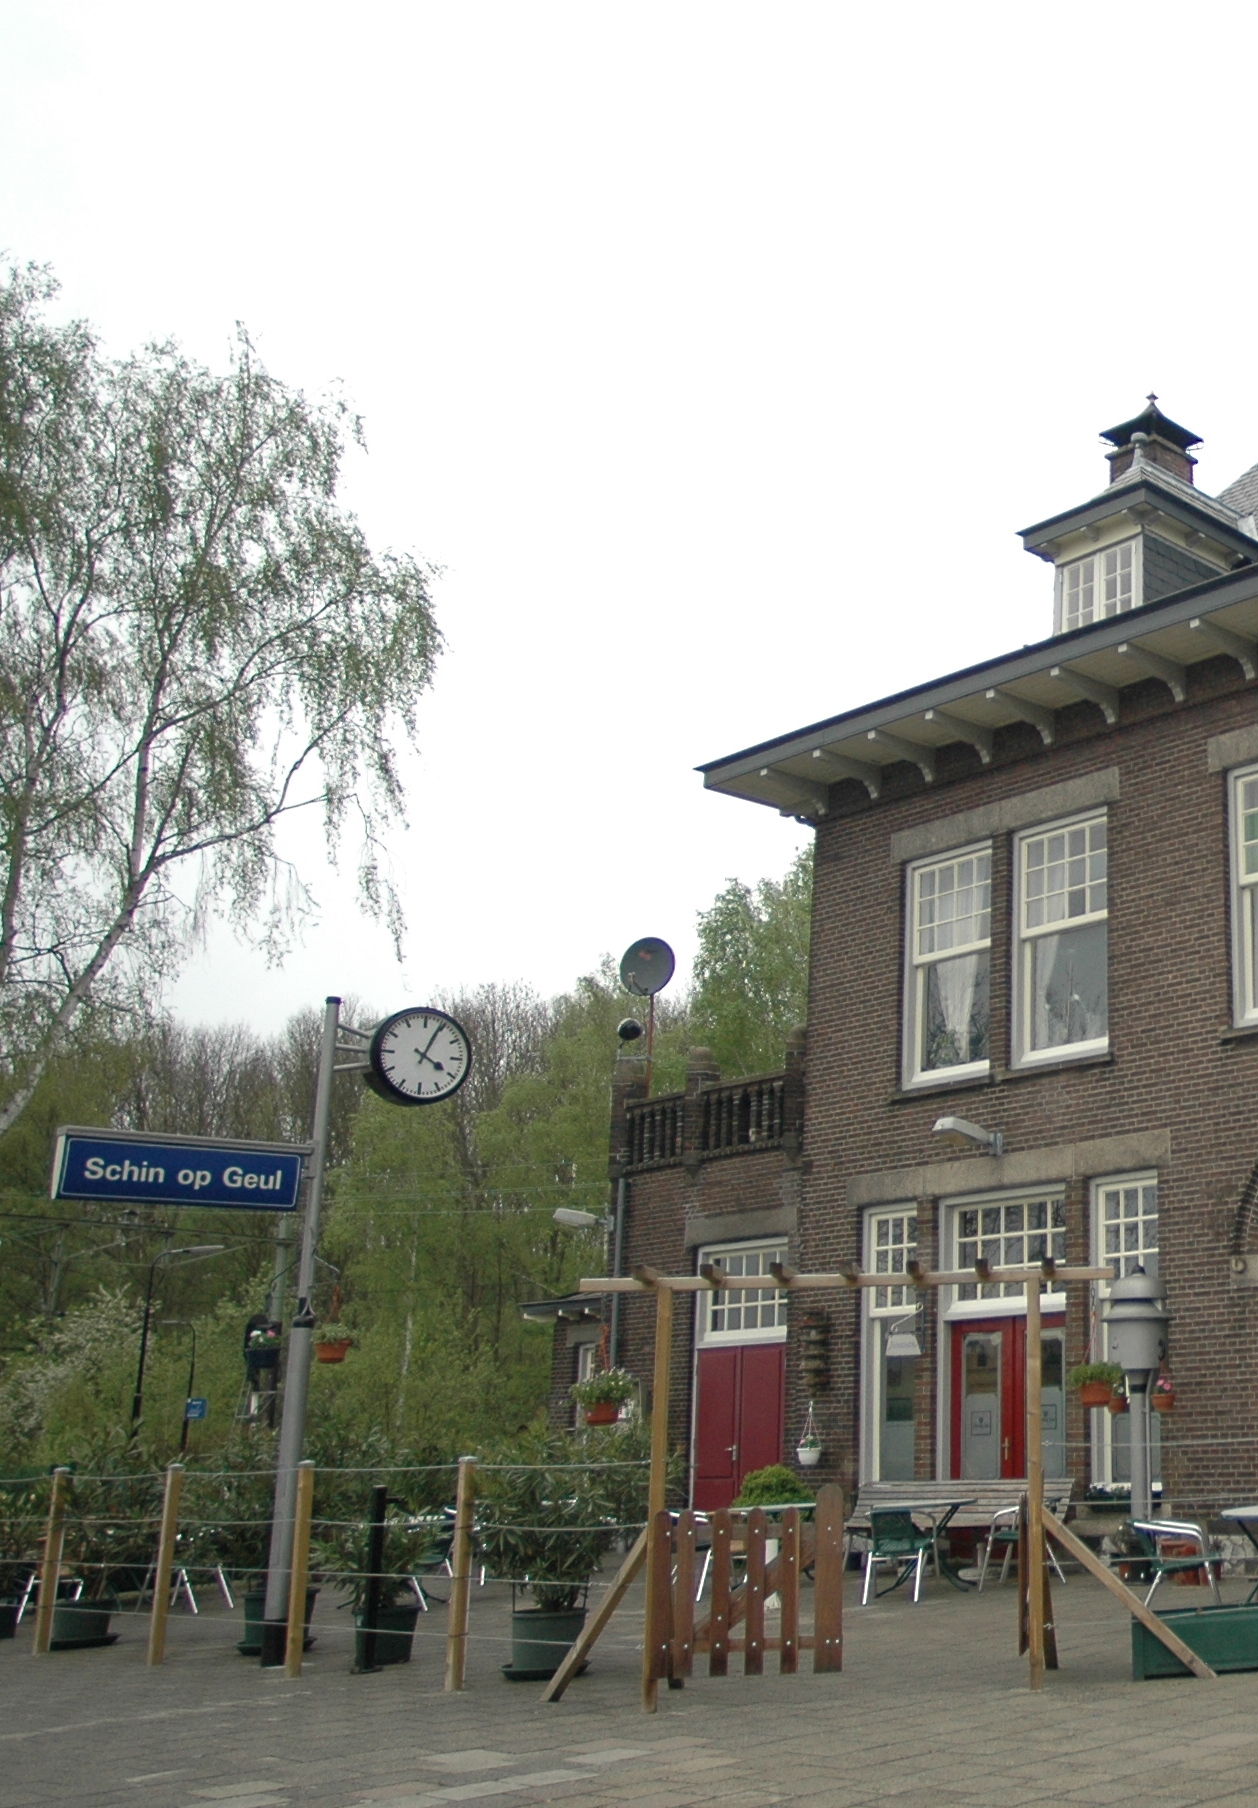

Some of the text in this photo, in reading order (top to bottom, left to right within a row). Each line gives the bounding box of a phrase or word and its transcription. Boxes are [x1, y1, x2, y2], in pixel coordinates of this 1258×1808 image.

[83, 1157, 282, 1190] Schin op Geul
